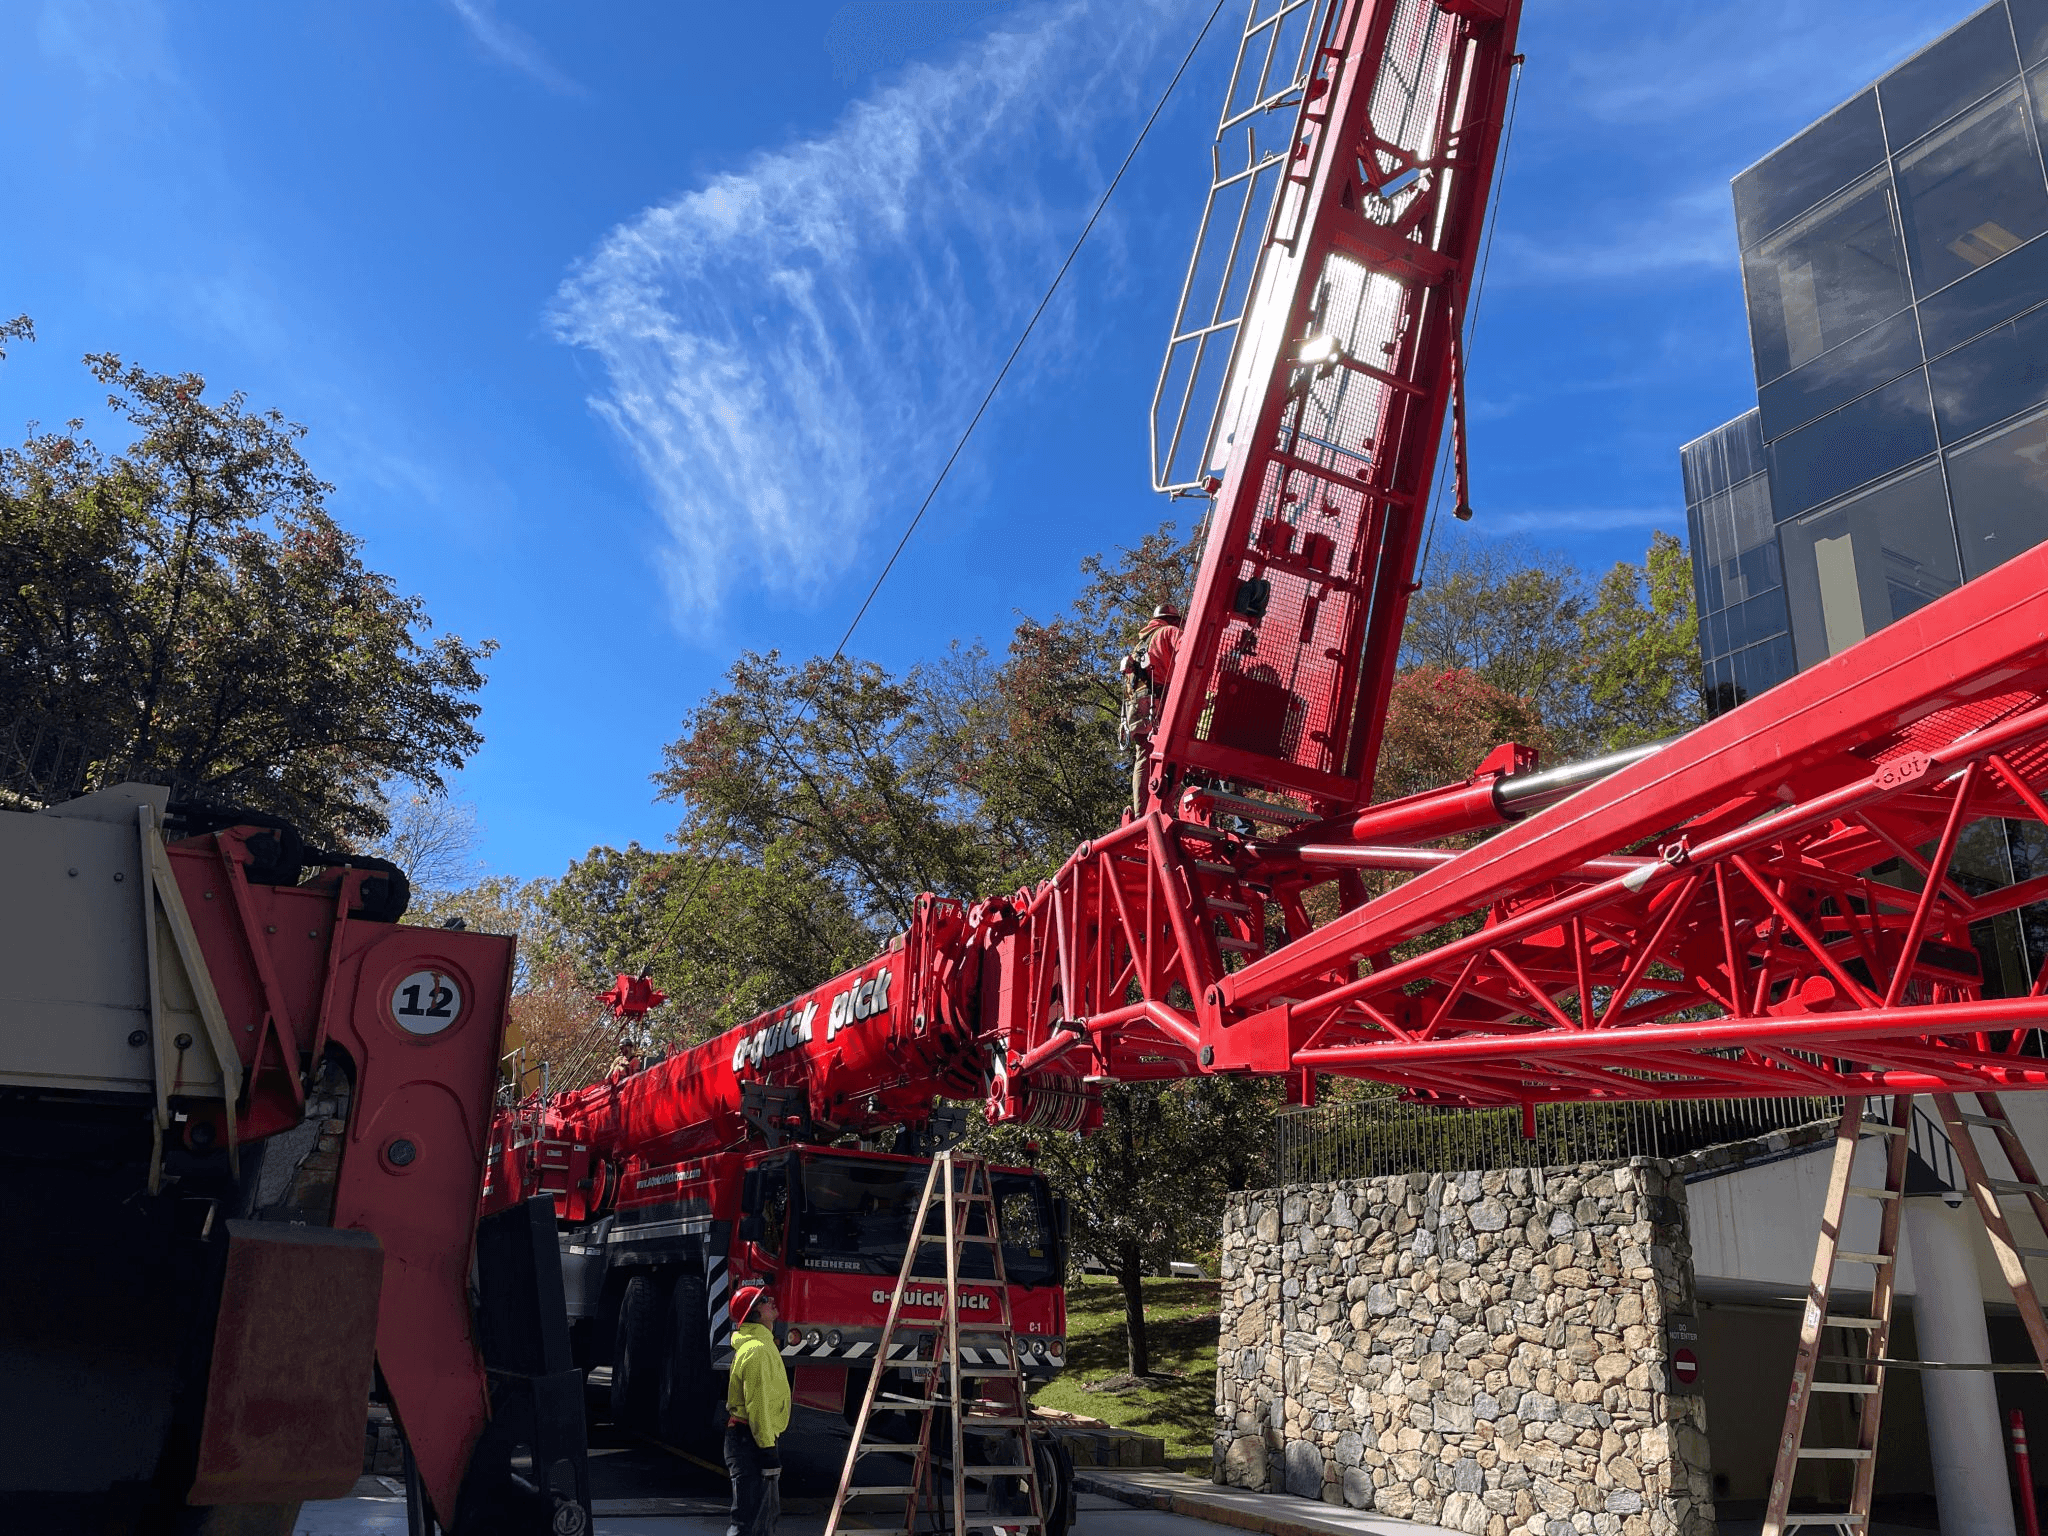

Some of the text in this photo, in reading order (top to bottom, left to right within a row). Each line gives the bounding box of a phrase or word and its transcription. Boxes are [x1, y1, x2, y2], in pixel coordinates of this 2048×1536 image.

[399, 985, 453, 1017] 12
[732, 966, 893, 1073] a-quick pick
[804, 1259, 861, 1270] LIEBHERR
[872, 1289, 990, 1310] a-uick ick
[1680, 1332, 1698, 1341] ENTER
